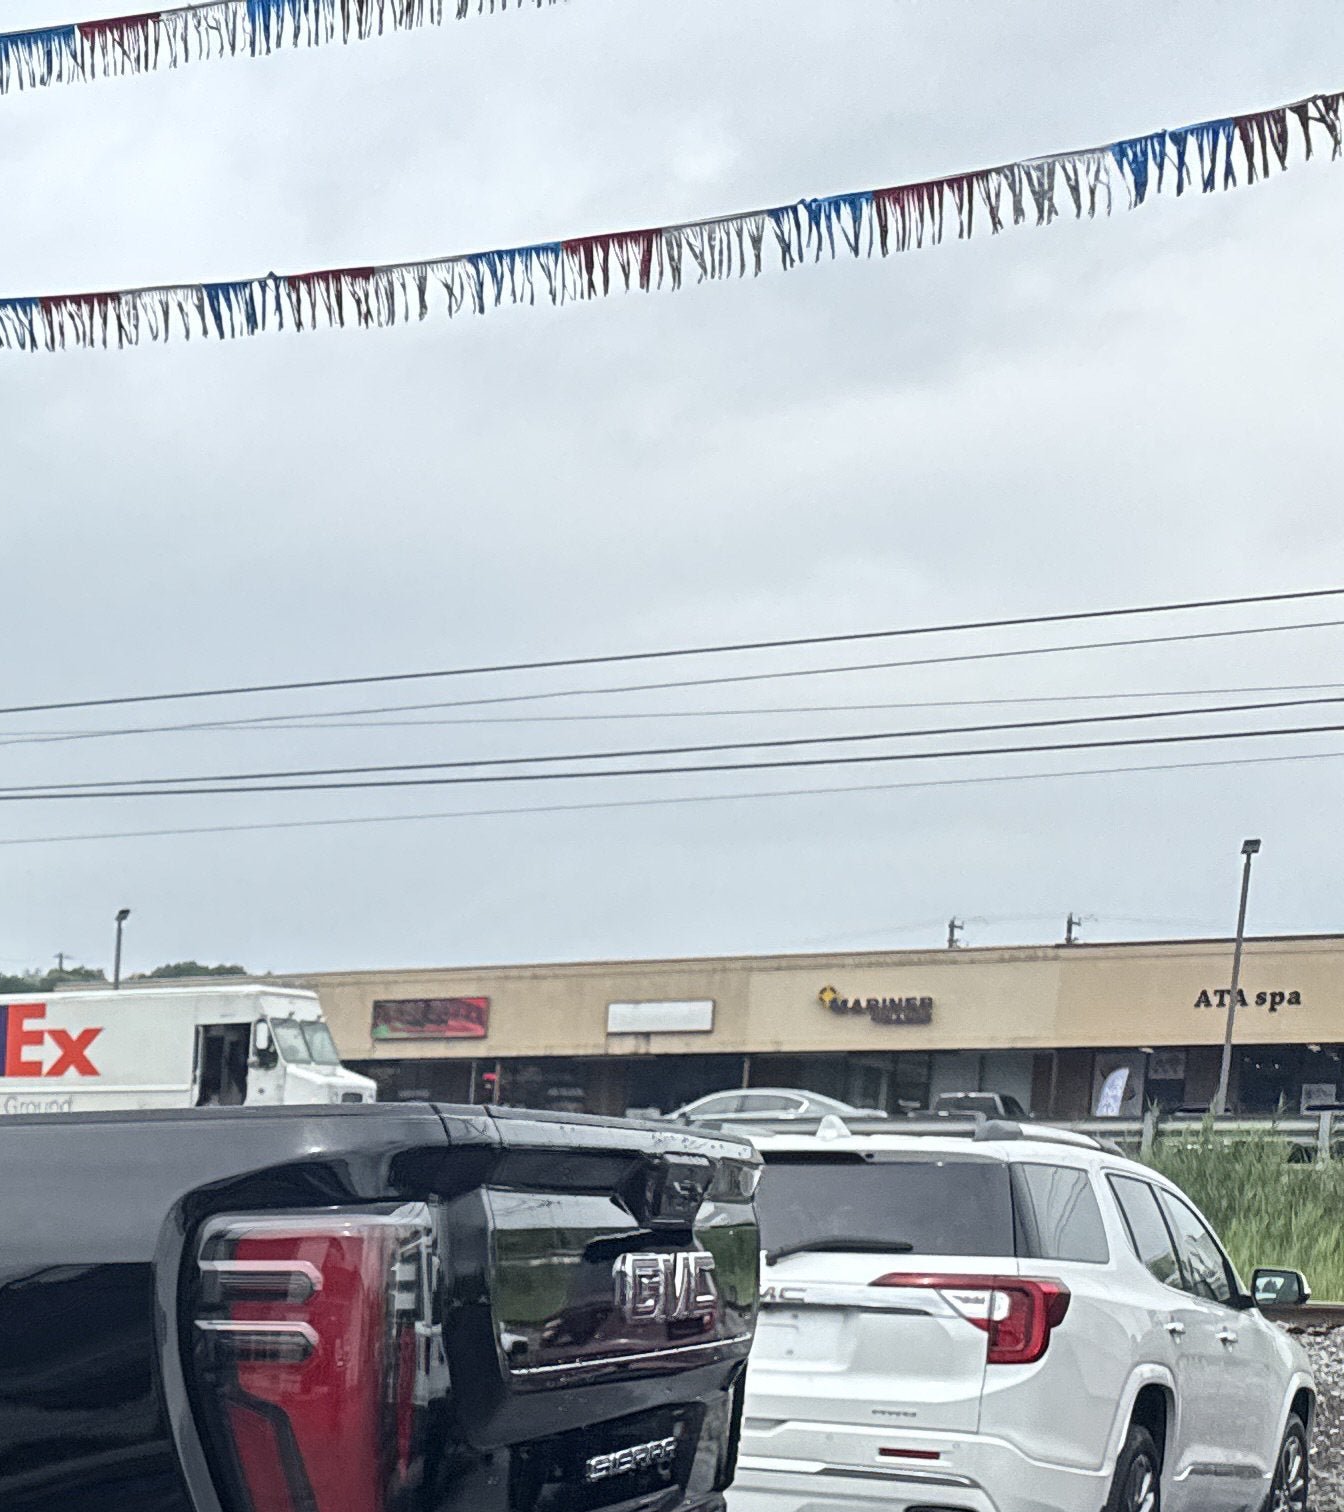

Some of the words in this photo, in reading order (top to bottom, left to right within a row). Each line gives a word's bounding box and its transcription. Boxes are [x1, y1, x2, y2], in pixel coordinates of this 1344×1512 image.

[1193, 988, 1248, 1008] ATA
[1254, 990, 1302, 1013] spa
[4, 1096, 74, 1114] Ground
[759, 1285, 807, 1301] MC
[585, 1437, 678, 1481] SIERRA
